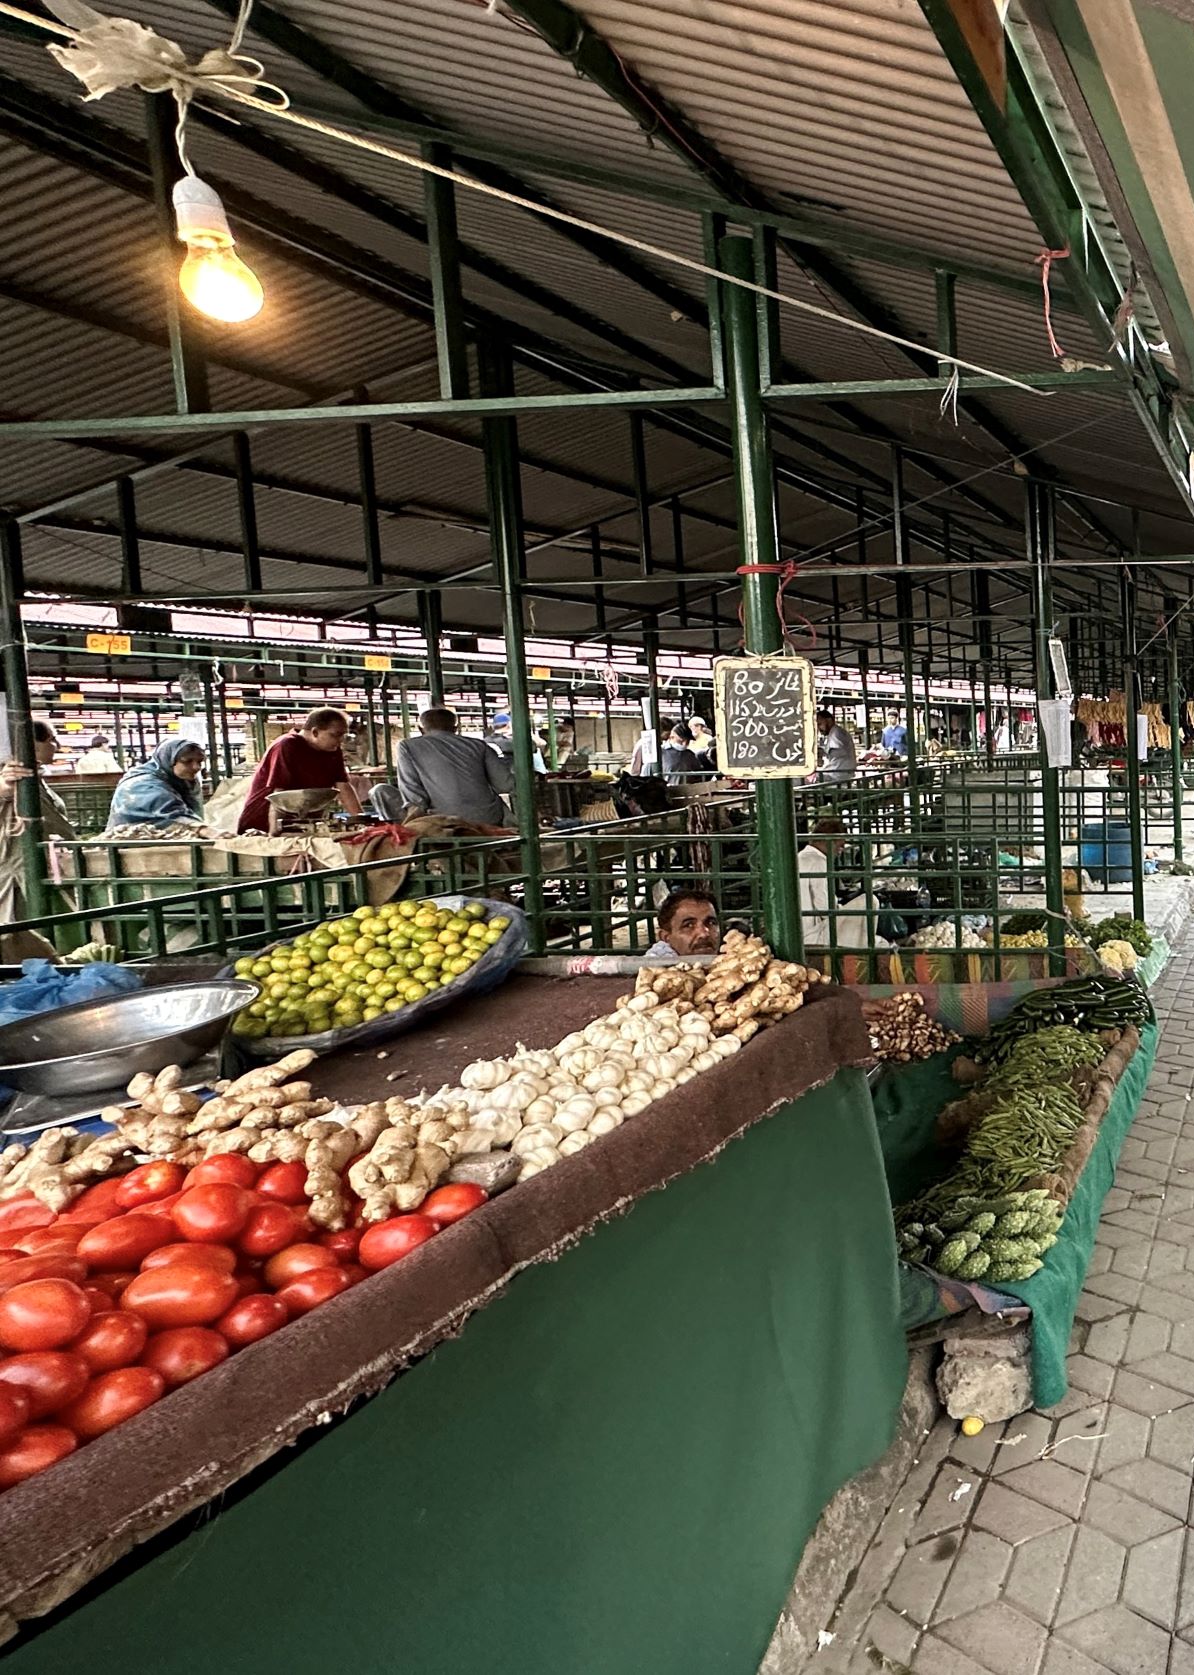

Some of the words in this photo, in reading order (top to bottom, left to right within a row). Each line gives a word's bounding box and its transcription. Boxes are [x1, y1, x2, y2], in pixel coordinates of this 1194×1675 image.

[733, 670, 764, 695] 80
[731, 716, 769, 737] 500
[732, 740, 758, 759] 180
